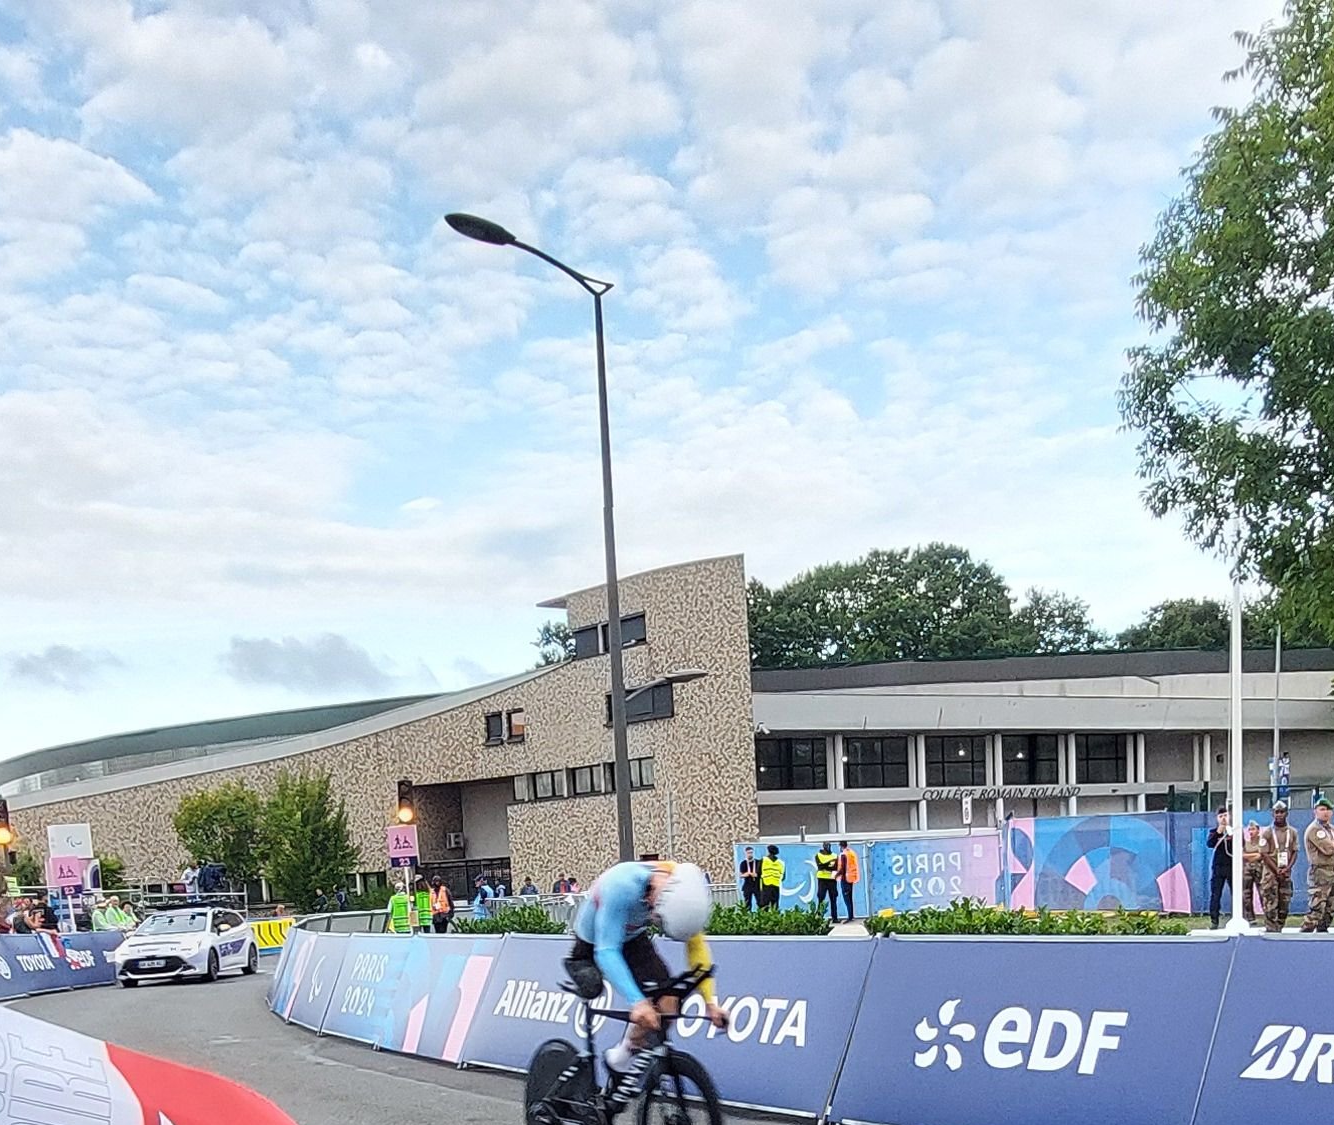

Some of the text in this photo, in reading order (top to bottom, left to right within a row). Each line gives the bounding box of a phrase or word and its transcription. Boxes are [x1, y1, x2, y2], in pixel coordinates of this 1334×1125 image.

[922, 786, 1082, 801] COLLÈGE ROMAIN ROLLAND
[16, 954, 56, 972] TOYOTA
[340, 985, 376, 1017] 2024
[493, 979, 573, 1024] Allianz
[675, 993, 808, 1048] OYOTA
